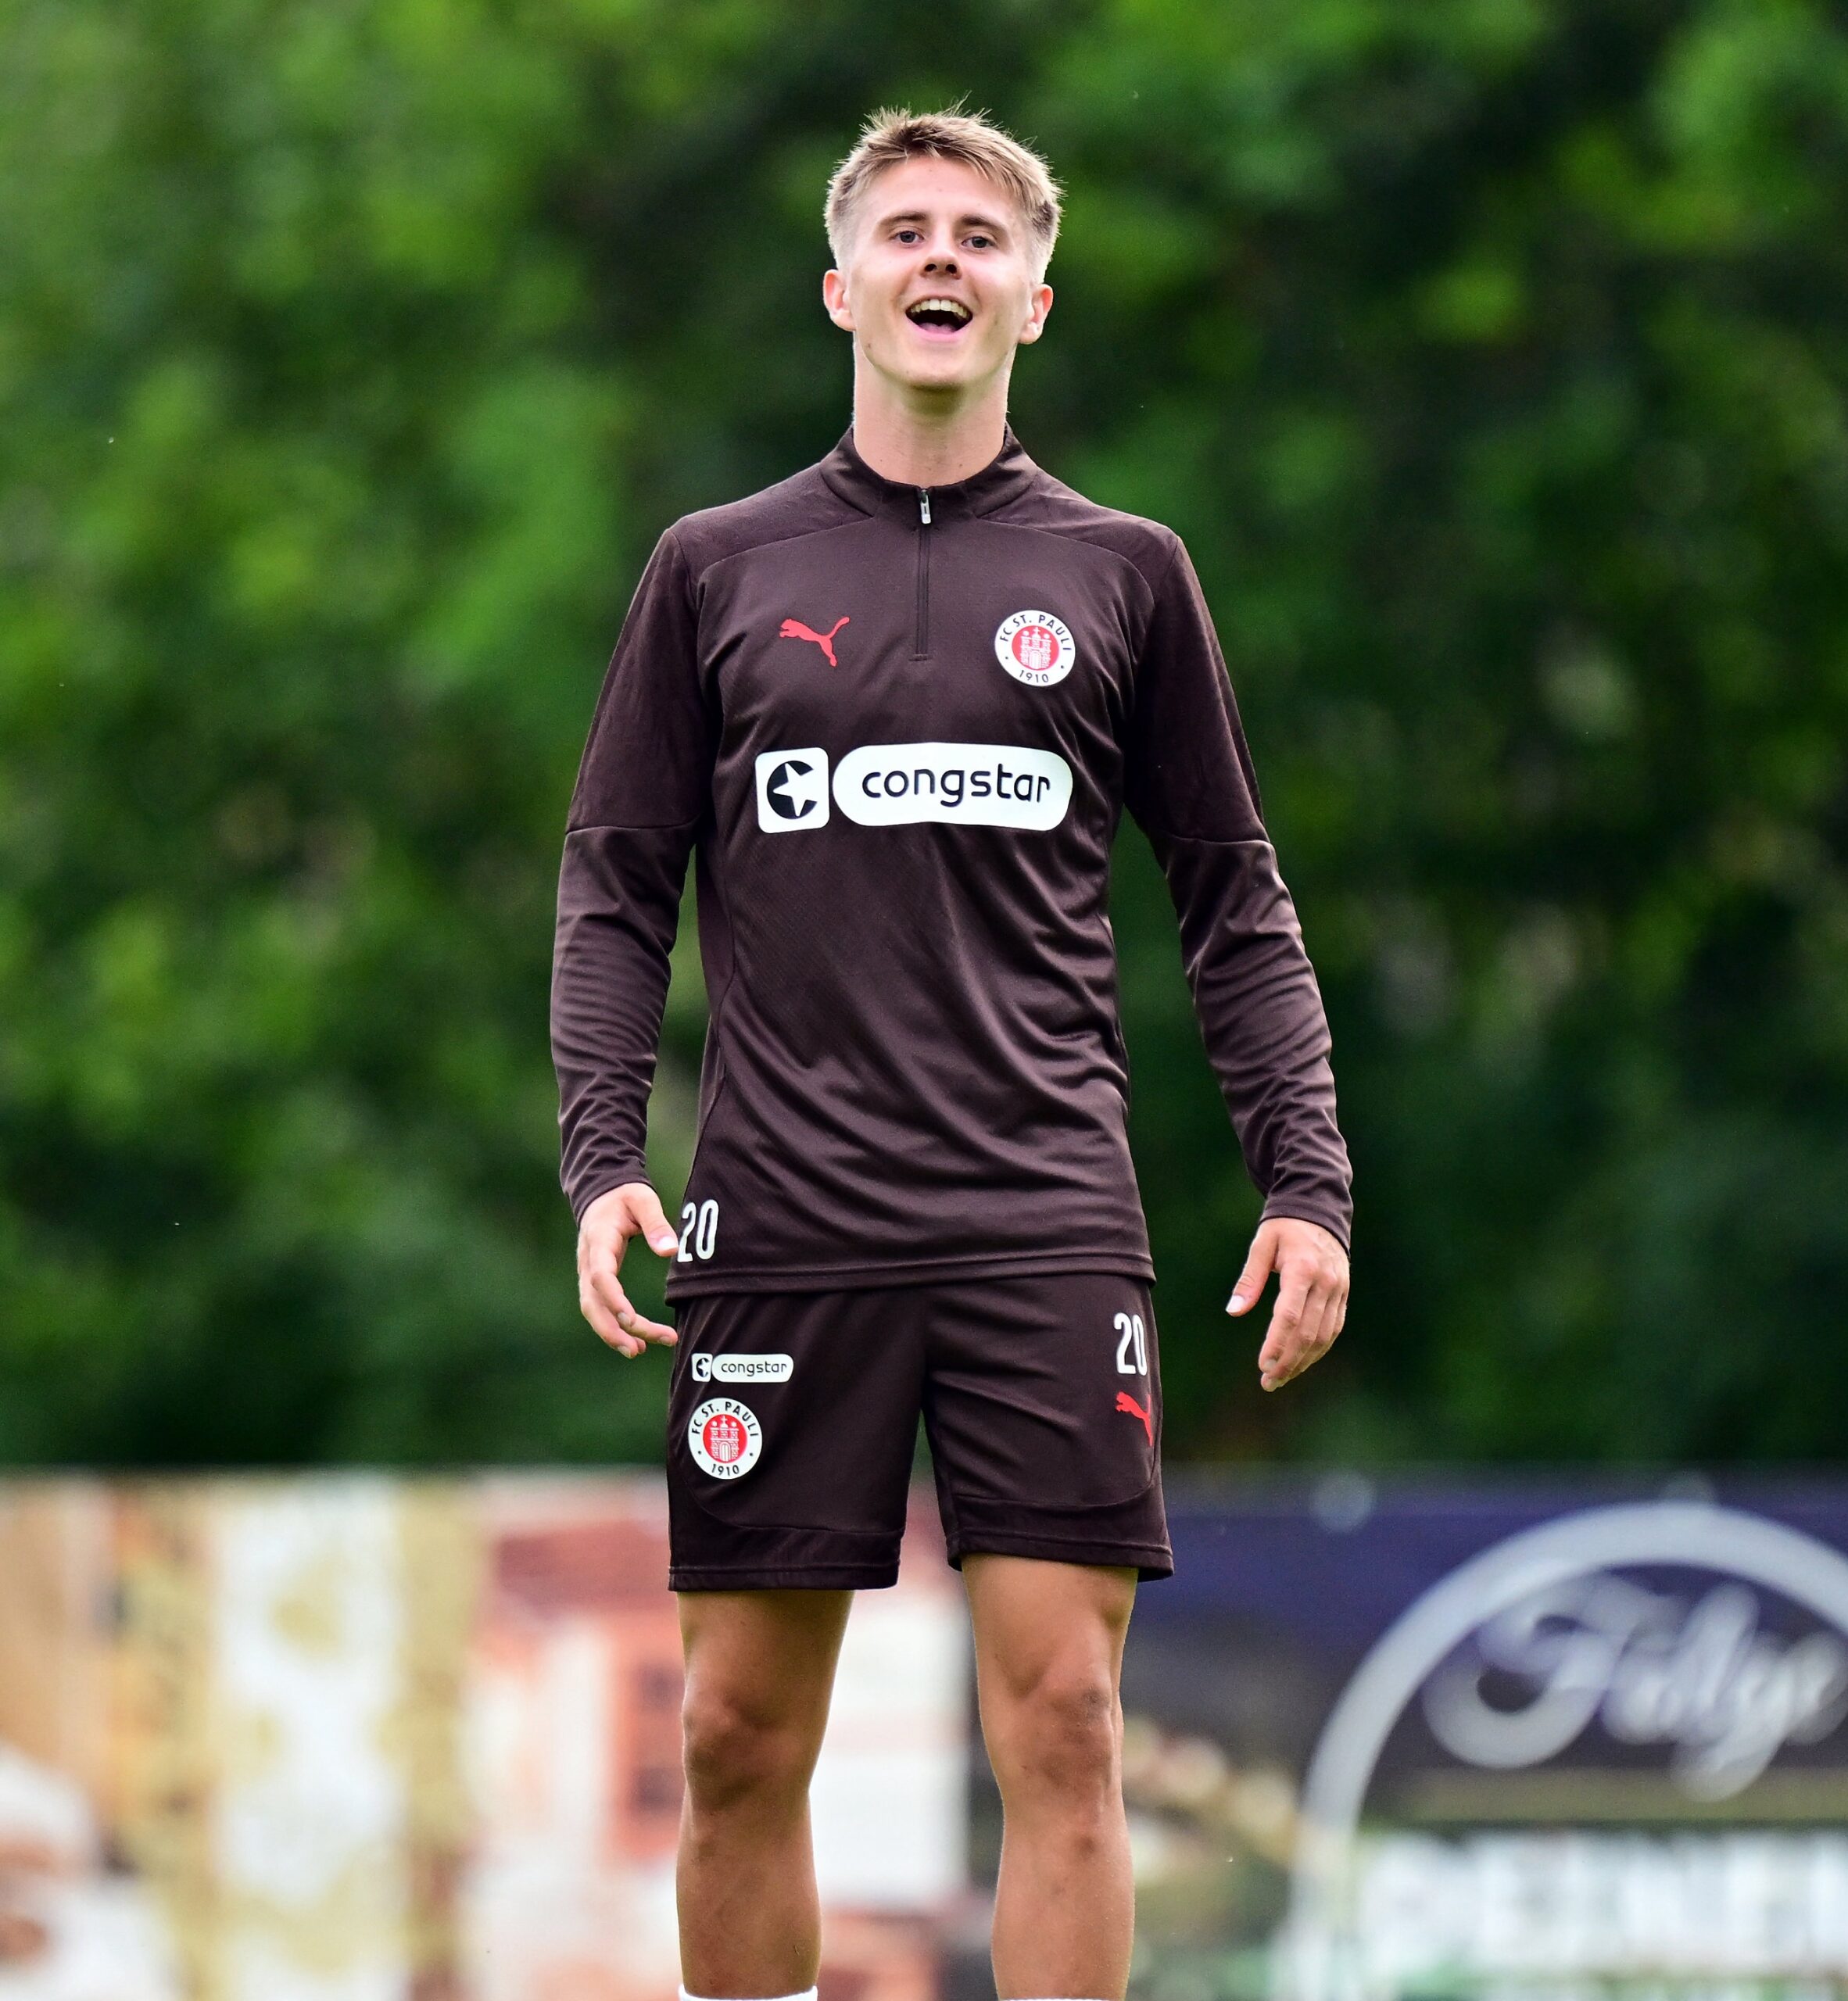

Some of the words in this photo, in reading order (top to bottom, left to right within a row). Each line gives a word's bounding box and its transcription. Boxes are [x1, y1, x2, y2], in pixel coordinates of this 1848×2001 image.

[1000, 628, 1013, 643] FC
[1013, 614, 1032, 627] ST.
[1038, 614, 1072, 651] PAULI
[1019, 669, 1049, 683] 1910
[862, 764, 1051, 807] congstar
[678, 1200, 719, 1262] 20
[1114, 1312, 1148, 1376] 20
[721, 1362, 787, 1376] congstar
[692, 1420, 702, 1434] FC
[701, 1403, 719, 1417] ST.
[725, 1402, 759, 1437] PAULI
[711, 1463, 740, 1476] 1910
